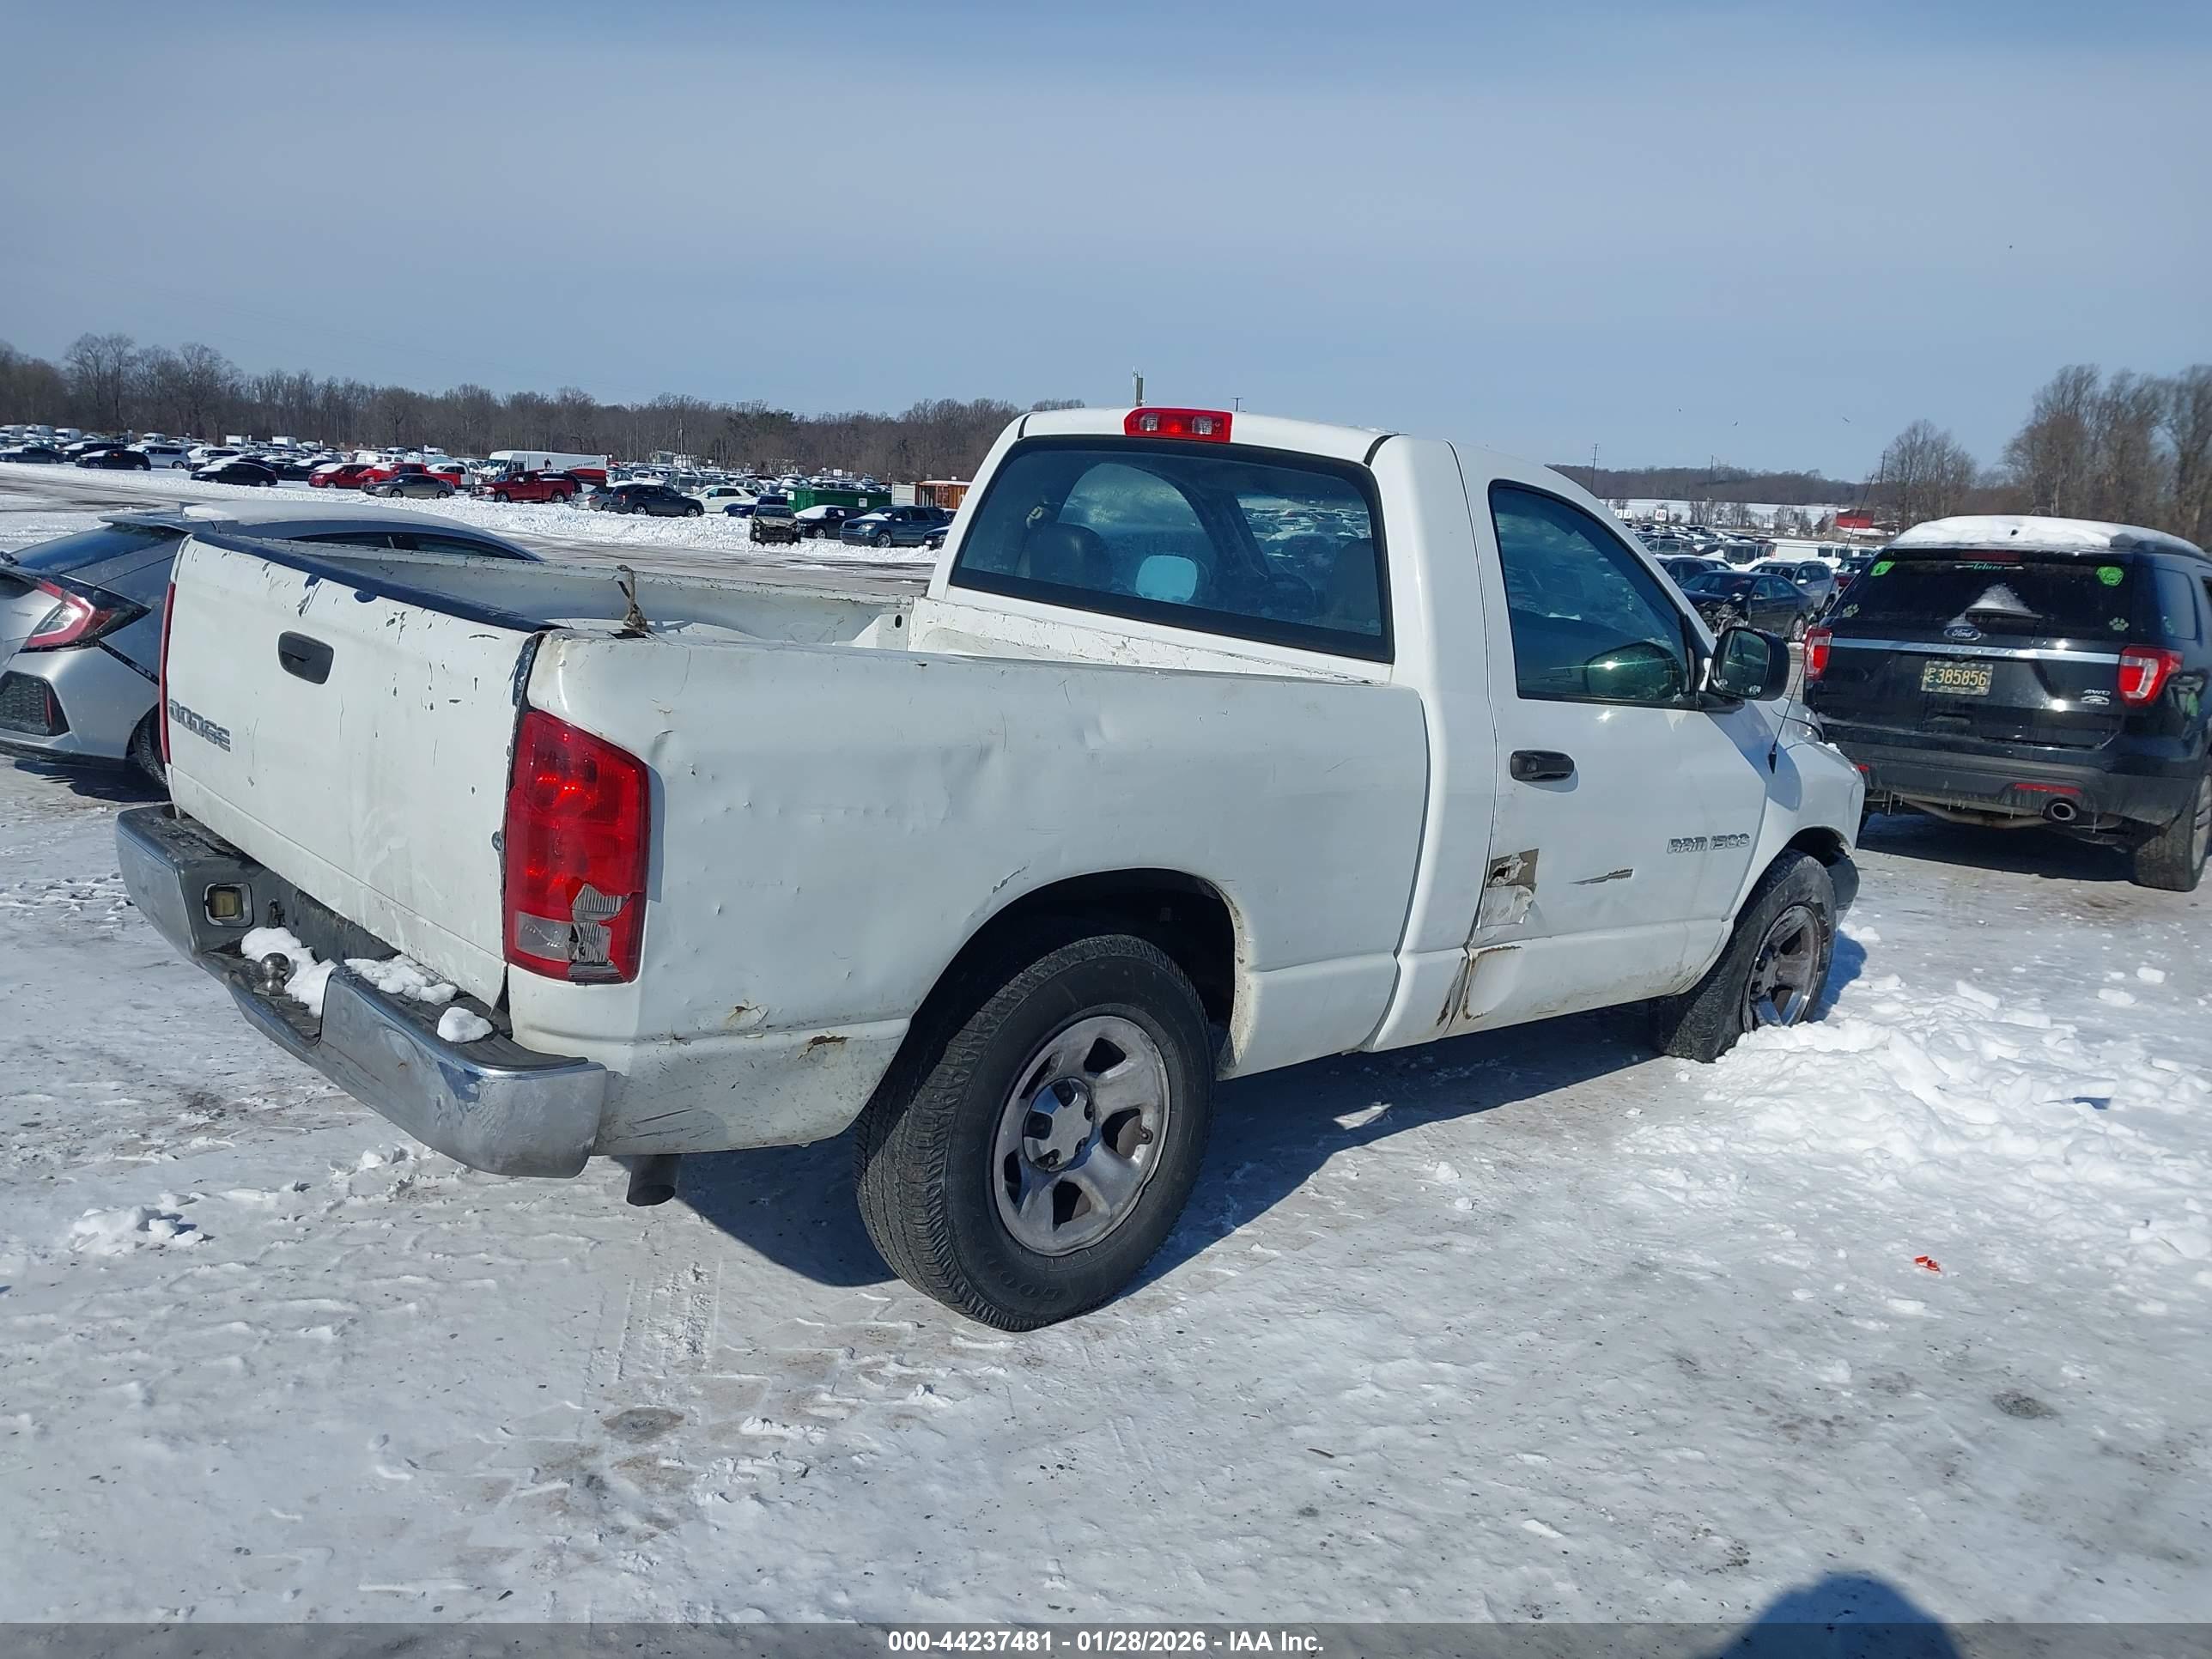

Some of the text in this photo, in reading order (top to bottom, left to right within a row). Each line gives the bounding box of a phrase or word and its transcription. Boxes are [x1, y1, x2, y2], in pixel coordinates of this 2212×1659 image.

[1951, 628, 1974, 637] Ford
[1936, 668, 1987, 687] 385856
[168, 698, 231, 753] DODGE
[1667, 833, 1750, 854] RAM 1500
